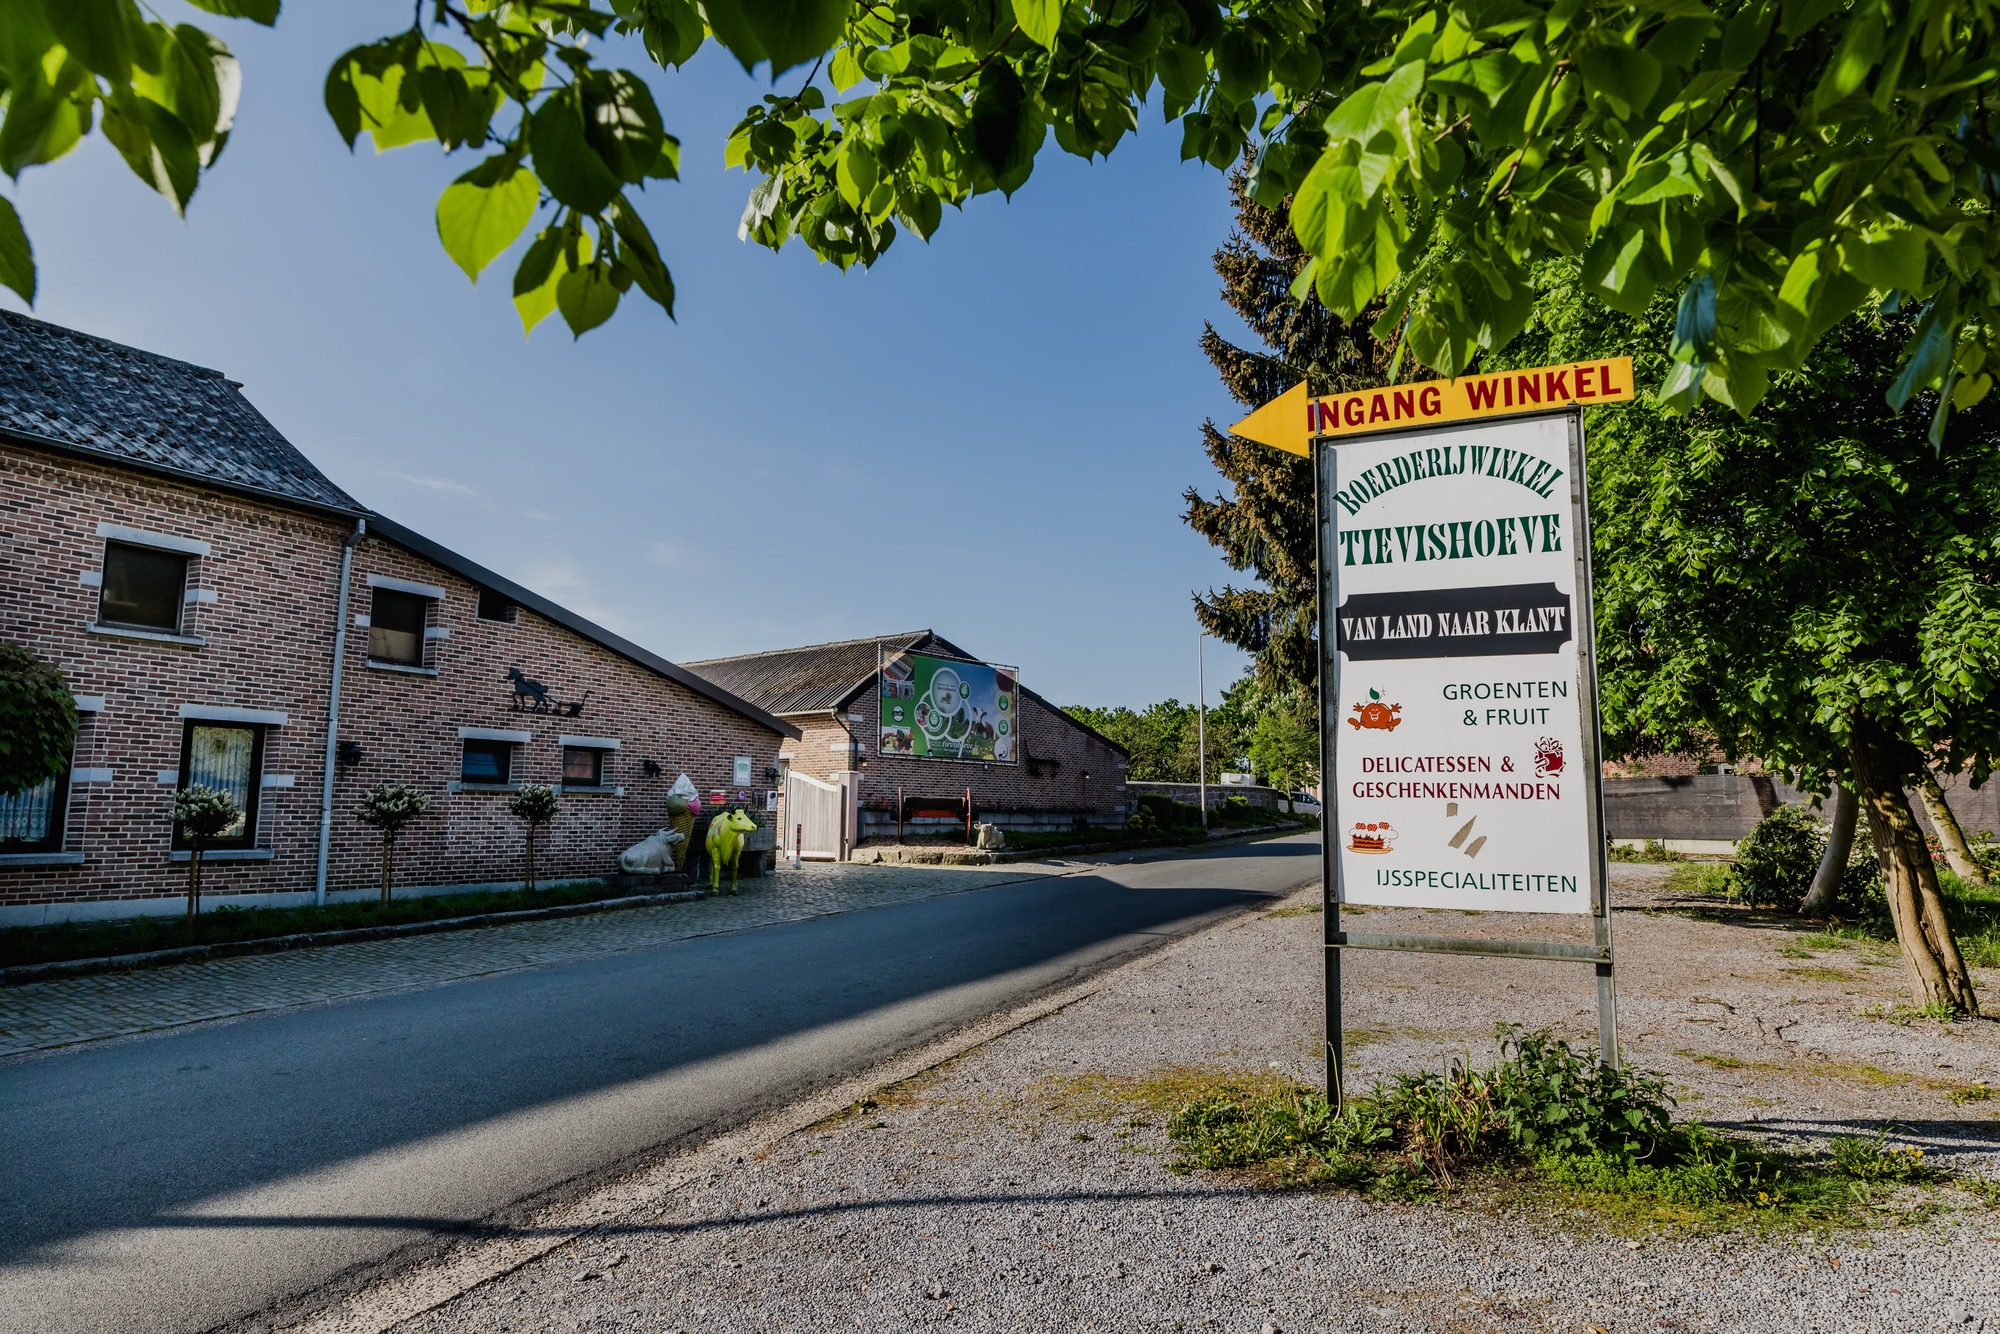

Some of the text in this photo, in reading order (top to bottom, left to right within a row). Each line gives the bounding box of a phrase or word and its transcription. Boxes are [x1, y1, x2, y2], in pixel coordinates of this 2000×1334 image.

[1307, 365, 1622, 433] INGANG WINKEL
[1332, 444, 1565, 516] BOERDERIJWINKEL
[1339, 513, 1562, 566] TIEVISHOEVE
[1341, 606, 1566, 641] VAN LAND NAAR KLANT
[1442, 680, 1568, 701] GROENTEN
[1462, 708, 1551, 726] & FRUIT
[1362, 755, 1515, 773] DELICATESSEN &
[1352, 781, 1560, 801] GESCHENKENMANDEN
[1376, 869, 1577, 893] IJSSPECIALITEITEN
